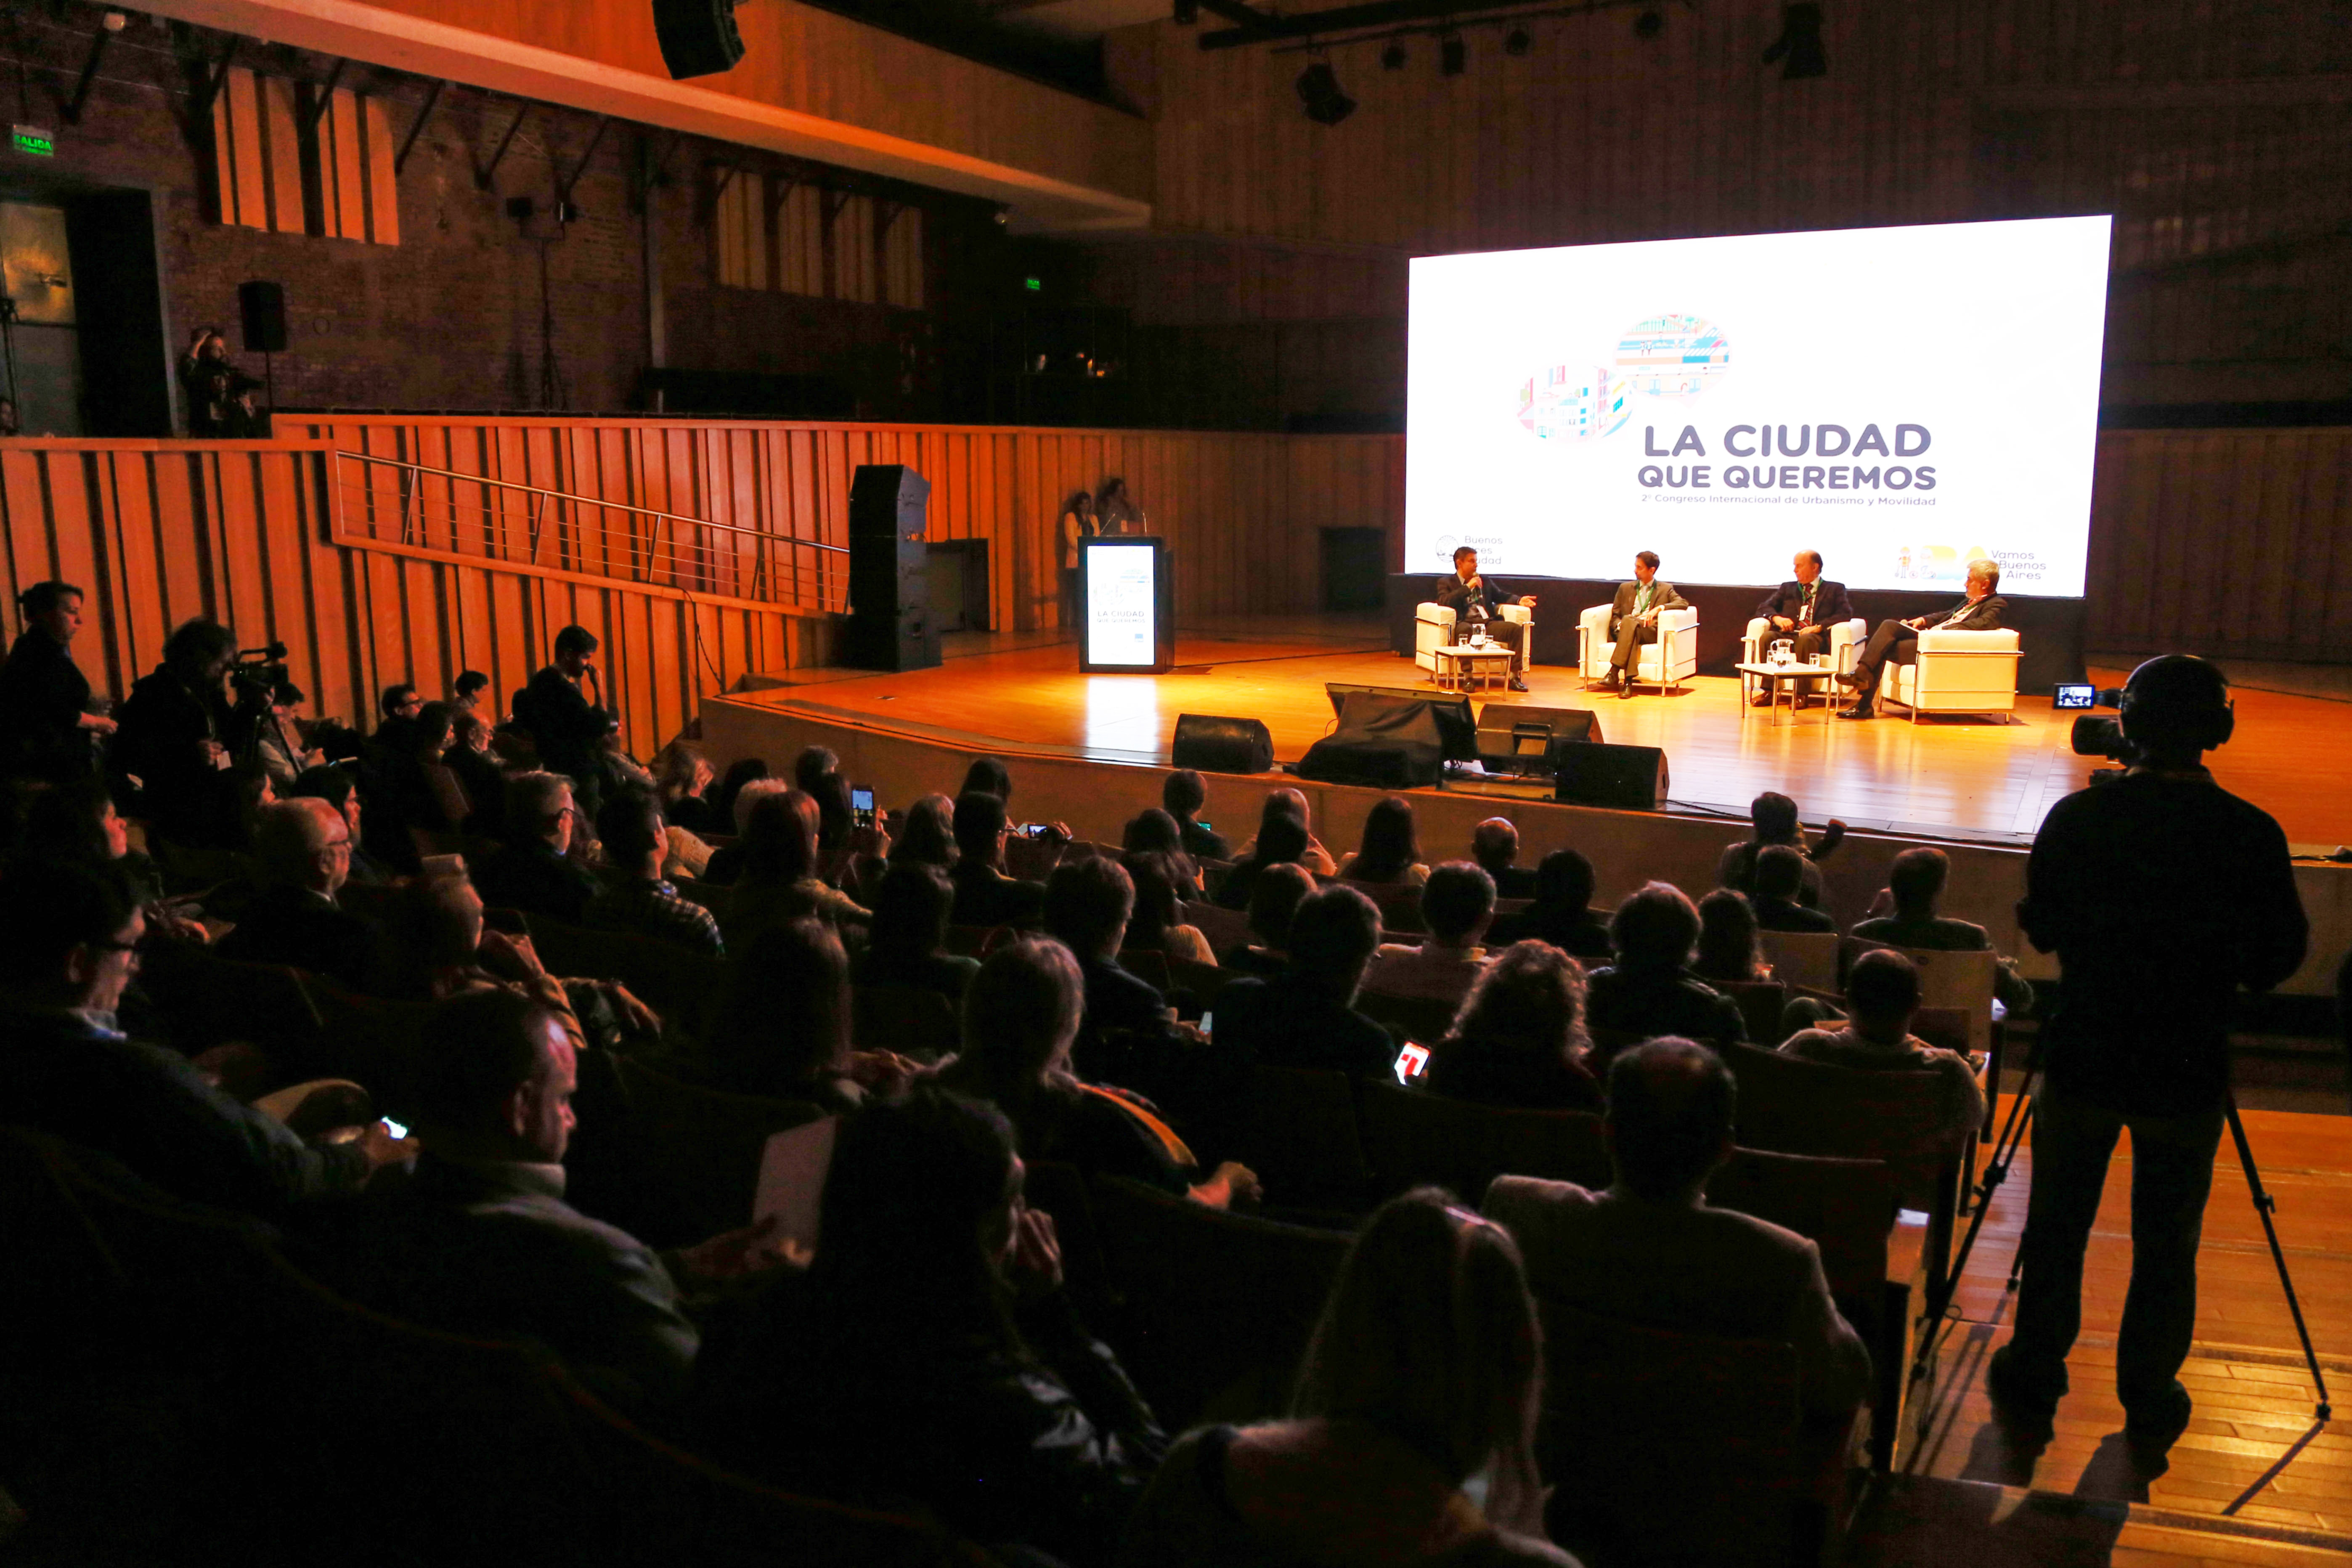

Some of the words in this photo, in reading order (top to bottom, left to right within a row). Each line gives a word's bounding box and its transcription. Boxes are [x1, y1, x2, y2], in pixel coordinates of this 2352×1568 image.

[14, 135, 52, 151] SALIDA
[1645, 425, 1706, 457] LA
[1724, 424, 1931, 457] CIUDAD
[1638, 465, 1711, 488] QUE
[1723, 466, 1936, 490] QUEREMOS
[1655, 494, 1705, 503] Congreso
[1710, 495, 1780, 504] Internacional
[1878, 497, 1936, 506] Movilidad
[1464, 535, 1503, 544] Buenos
[1991, 550, 2034, 560] Vamos
[1999, 560, 2046, 570] Buenos
[2006, 570, 2041, 579] Aires
